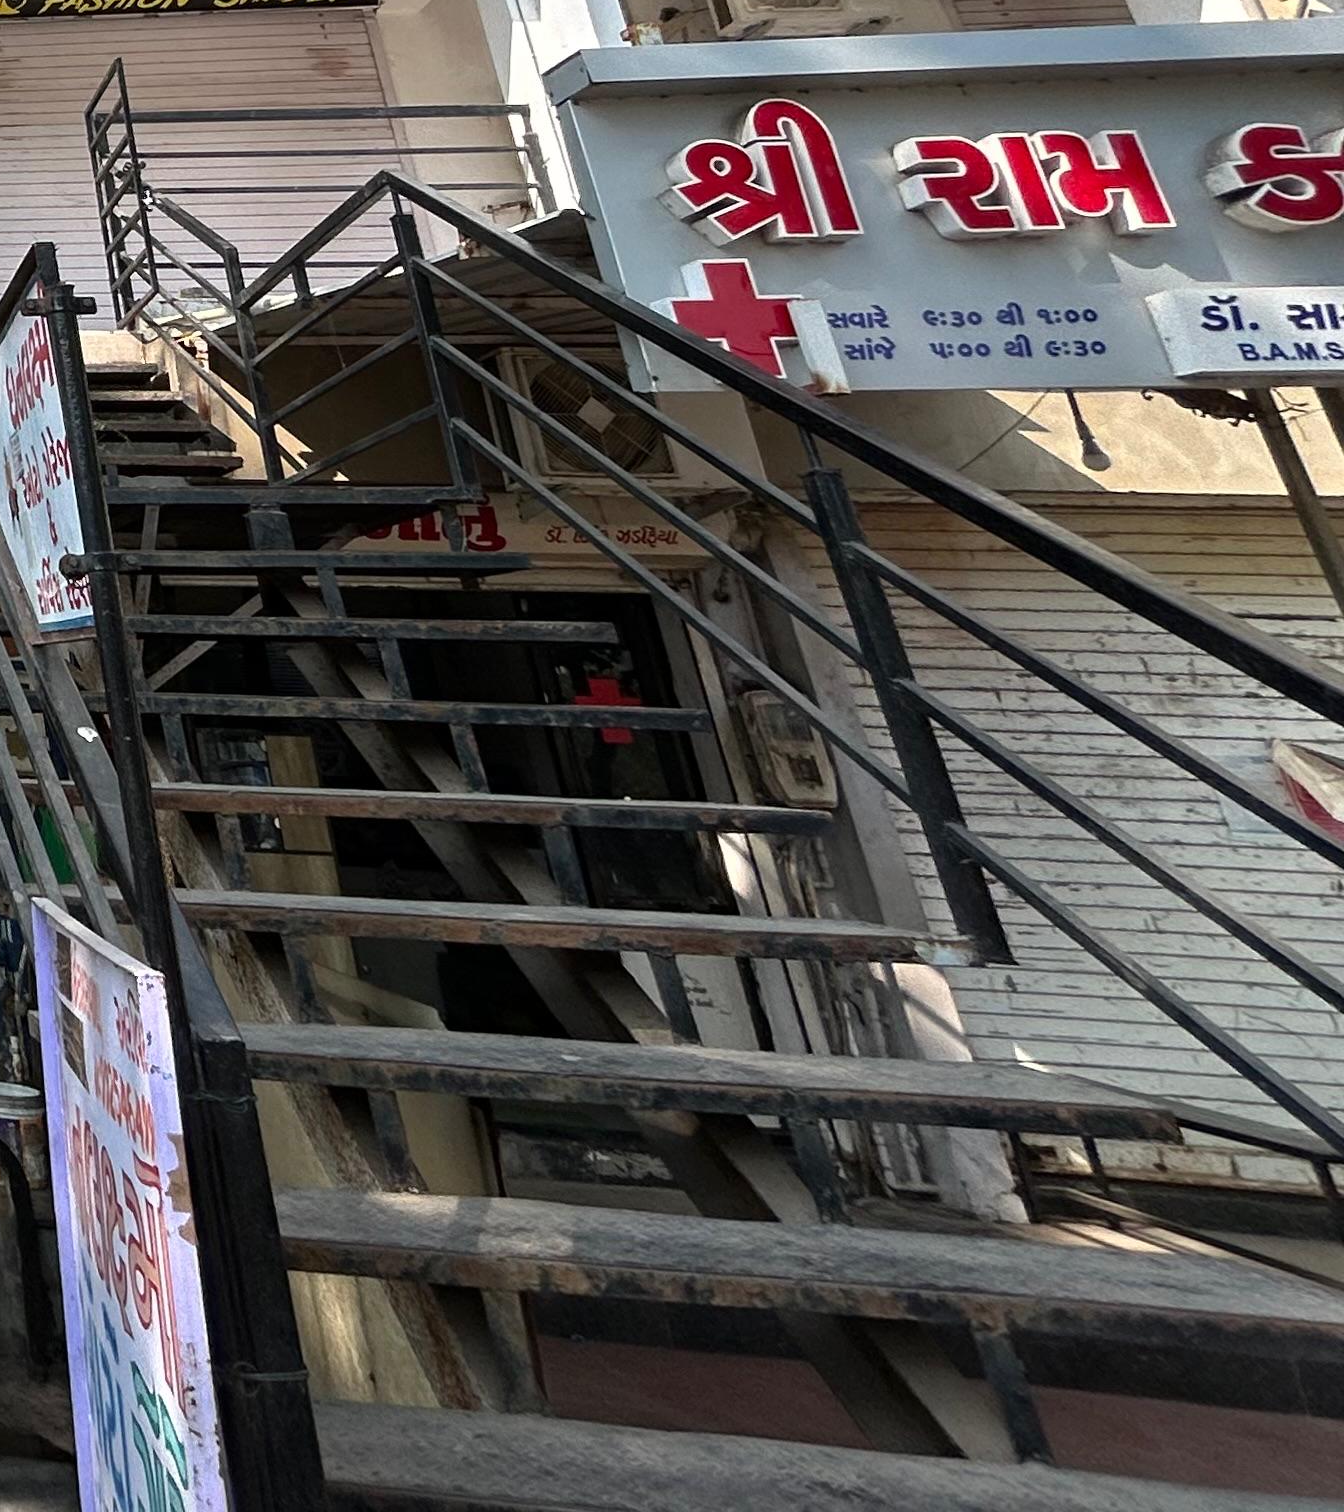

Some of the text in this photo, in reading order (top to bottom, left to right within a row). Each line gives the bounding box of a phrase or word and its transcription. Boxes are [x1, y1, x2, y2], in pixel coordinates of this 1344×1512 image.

[670, 97, 1179, 240] શ્રી રામ
[827, 304, 890, 330] સવારે
[923, 307, 983, 328] ૯:૩૦
[996, 301, 1026, 329] થી
[1201, 294, 1260, 333] ડૉ.
[843, 333, 1107, 361] સાંજે ૫:૦૦ થી ૯:૩૦
